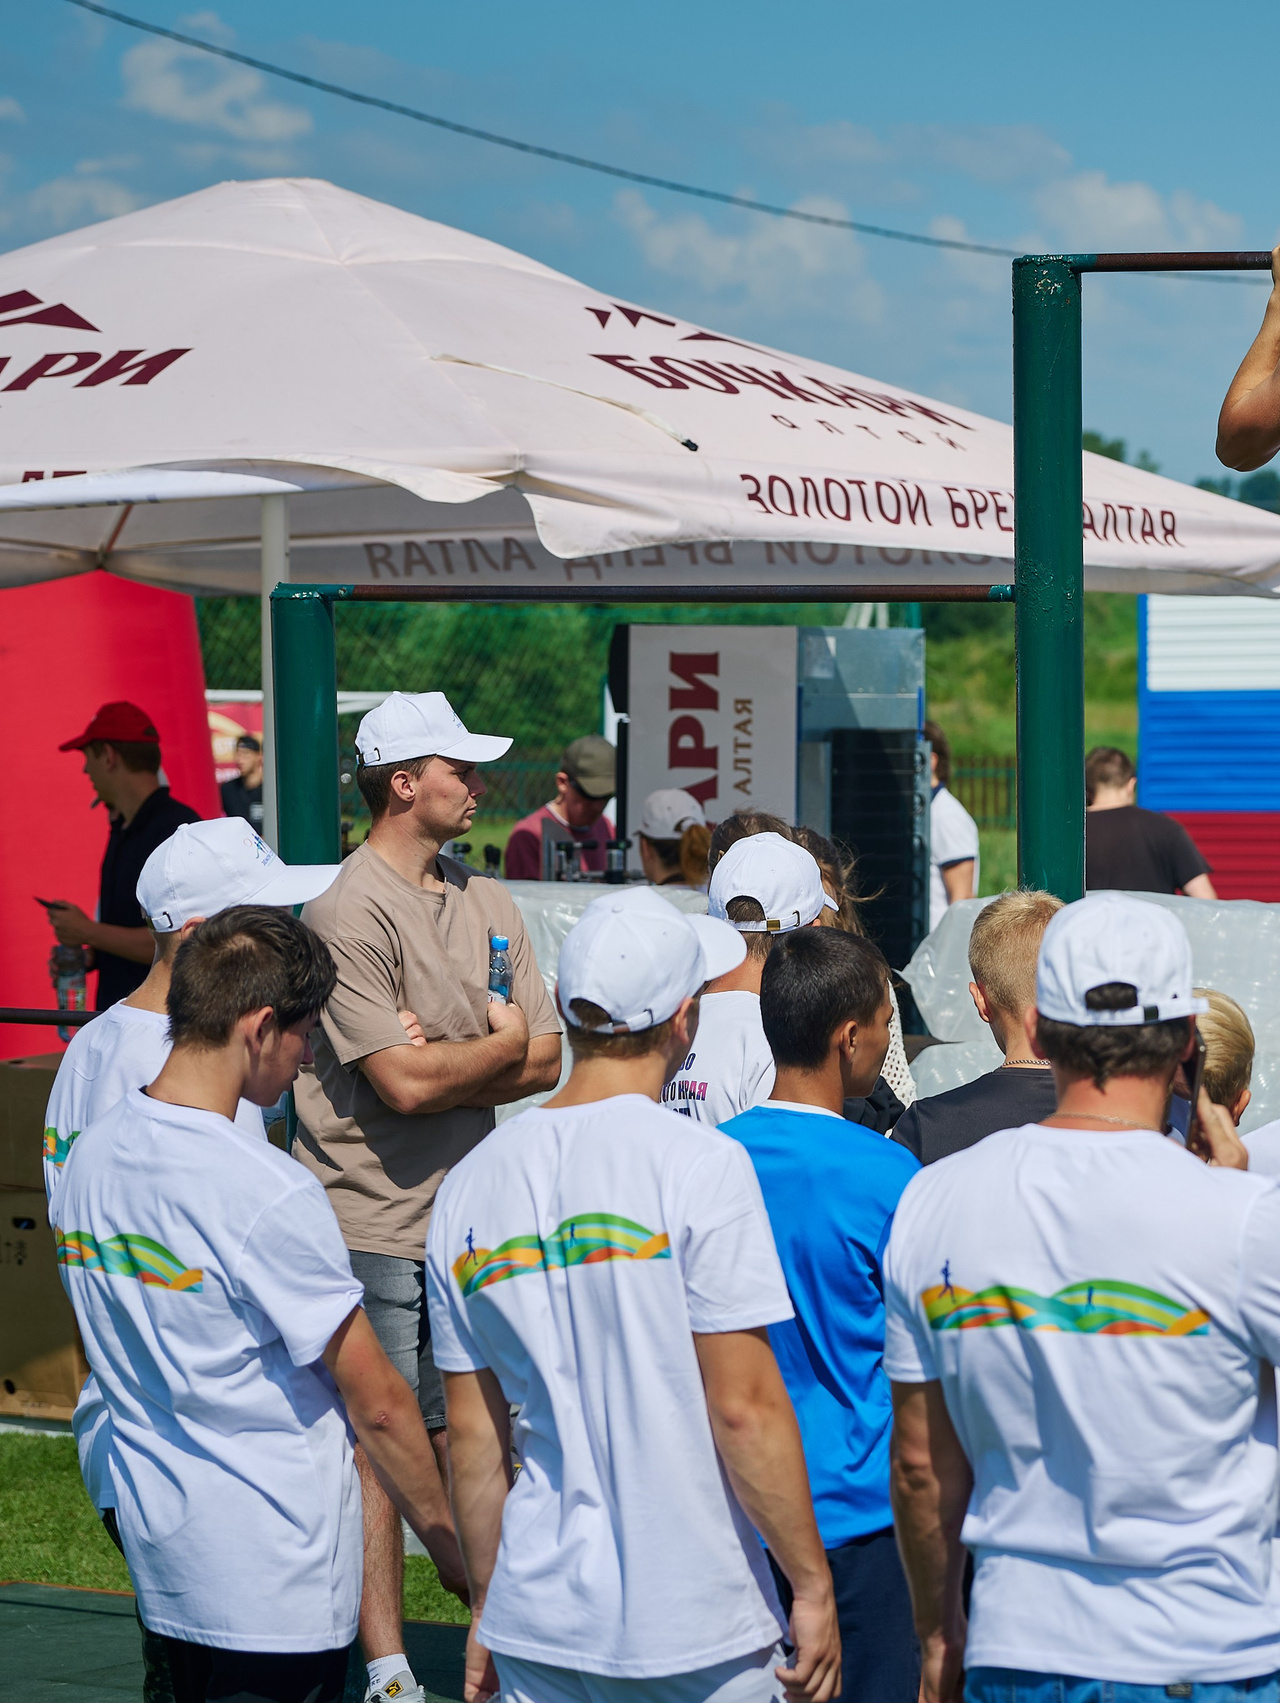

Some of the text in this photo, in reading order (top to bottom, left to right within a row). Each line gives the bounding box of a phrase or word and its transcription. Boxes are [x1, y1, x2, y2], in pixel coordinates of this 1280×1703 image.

[739, 473, 933, 527] ЗОЛОТОЙ
[942, 486, 1014, 532] БРЕ
[733, 698, 753, 796] АЛТАЯ
